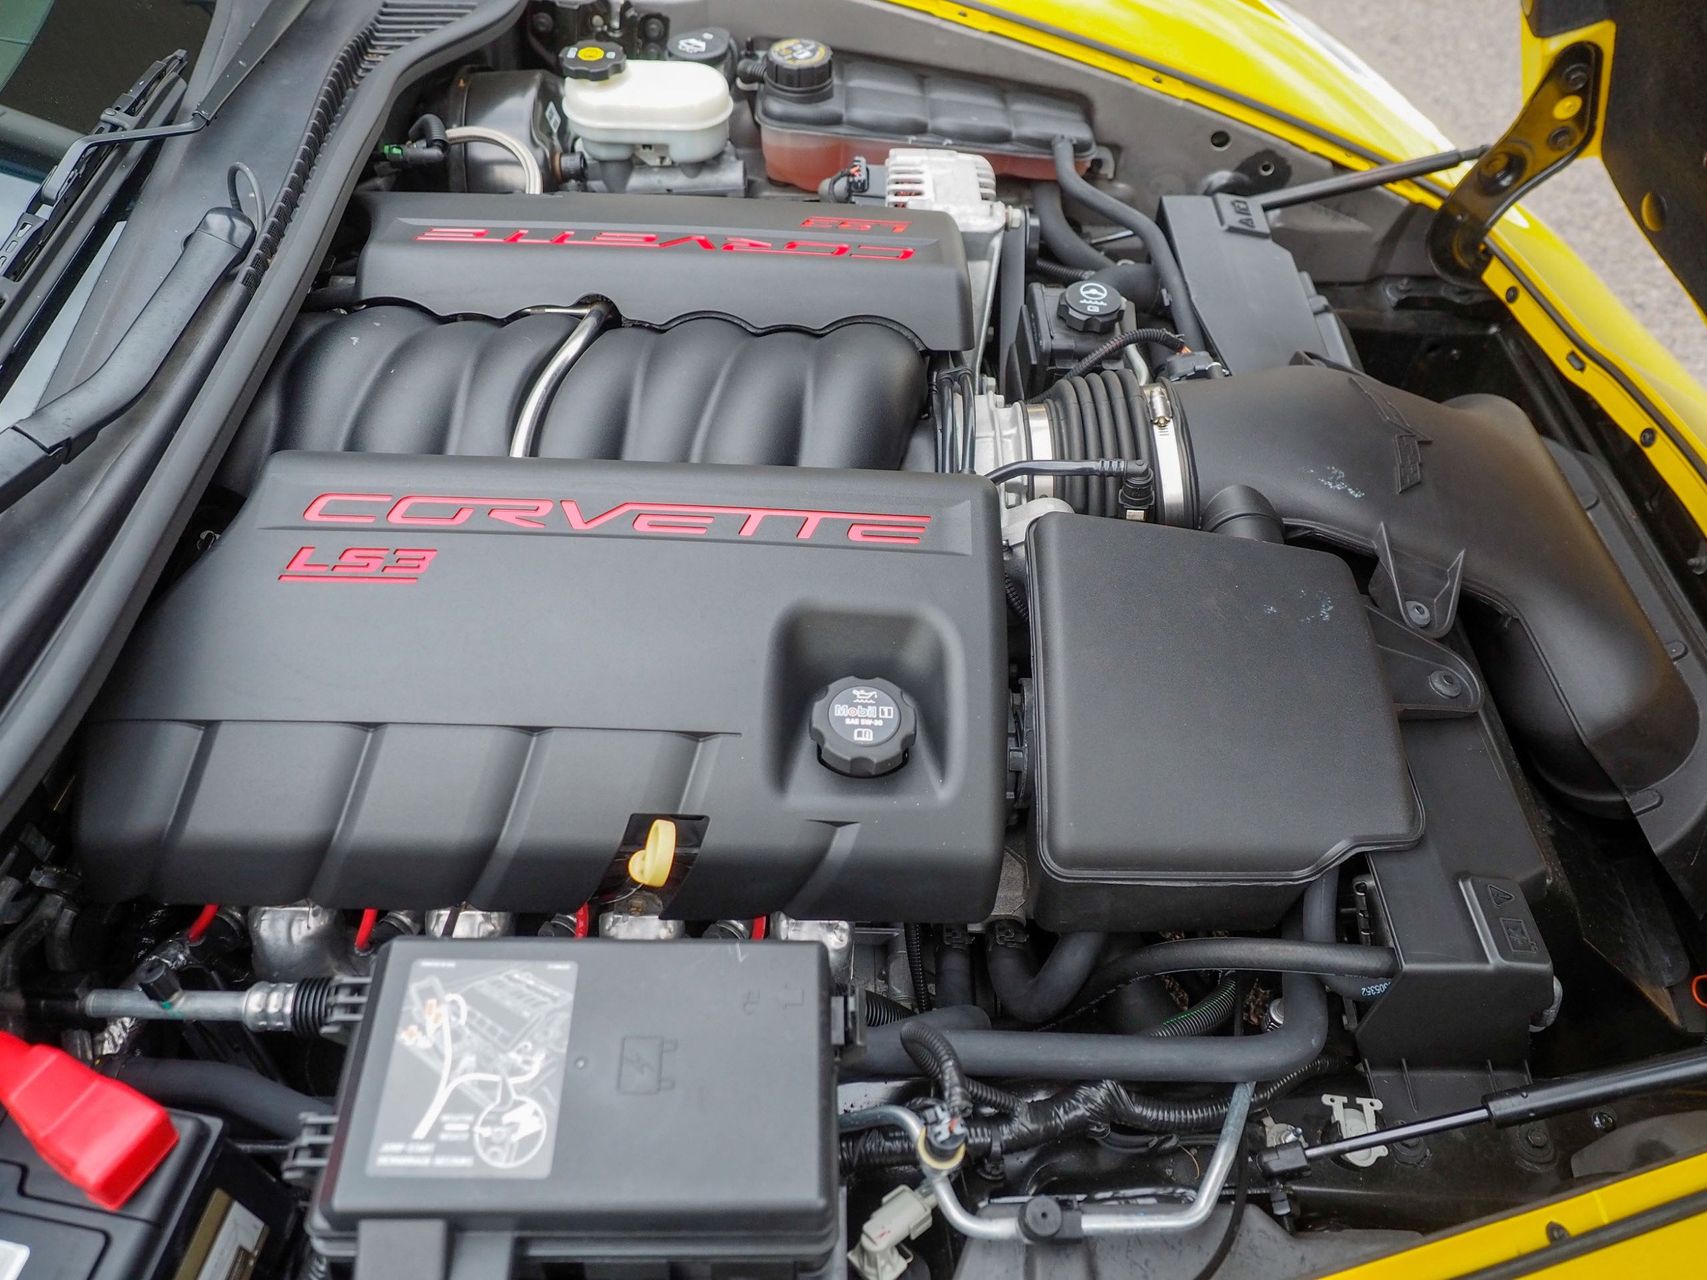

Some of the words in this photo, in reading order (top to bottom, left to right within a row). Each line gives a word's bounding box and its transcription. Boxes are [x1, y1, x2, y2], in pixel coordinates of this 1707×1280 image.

[801, 215, 912, 233] LS3
[416, 227, 915, 261] CORVETTE
[303, 493, 932, 544] CORVETTE
[282, 546, 438, 578] LS3
[834, 704, 877, 718] Mobil
